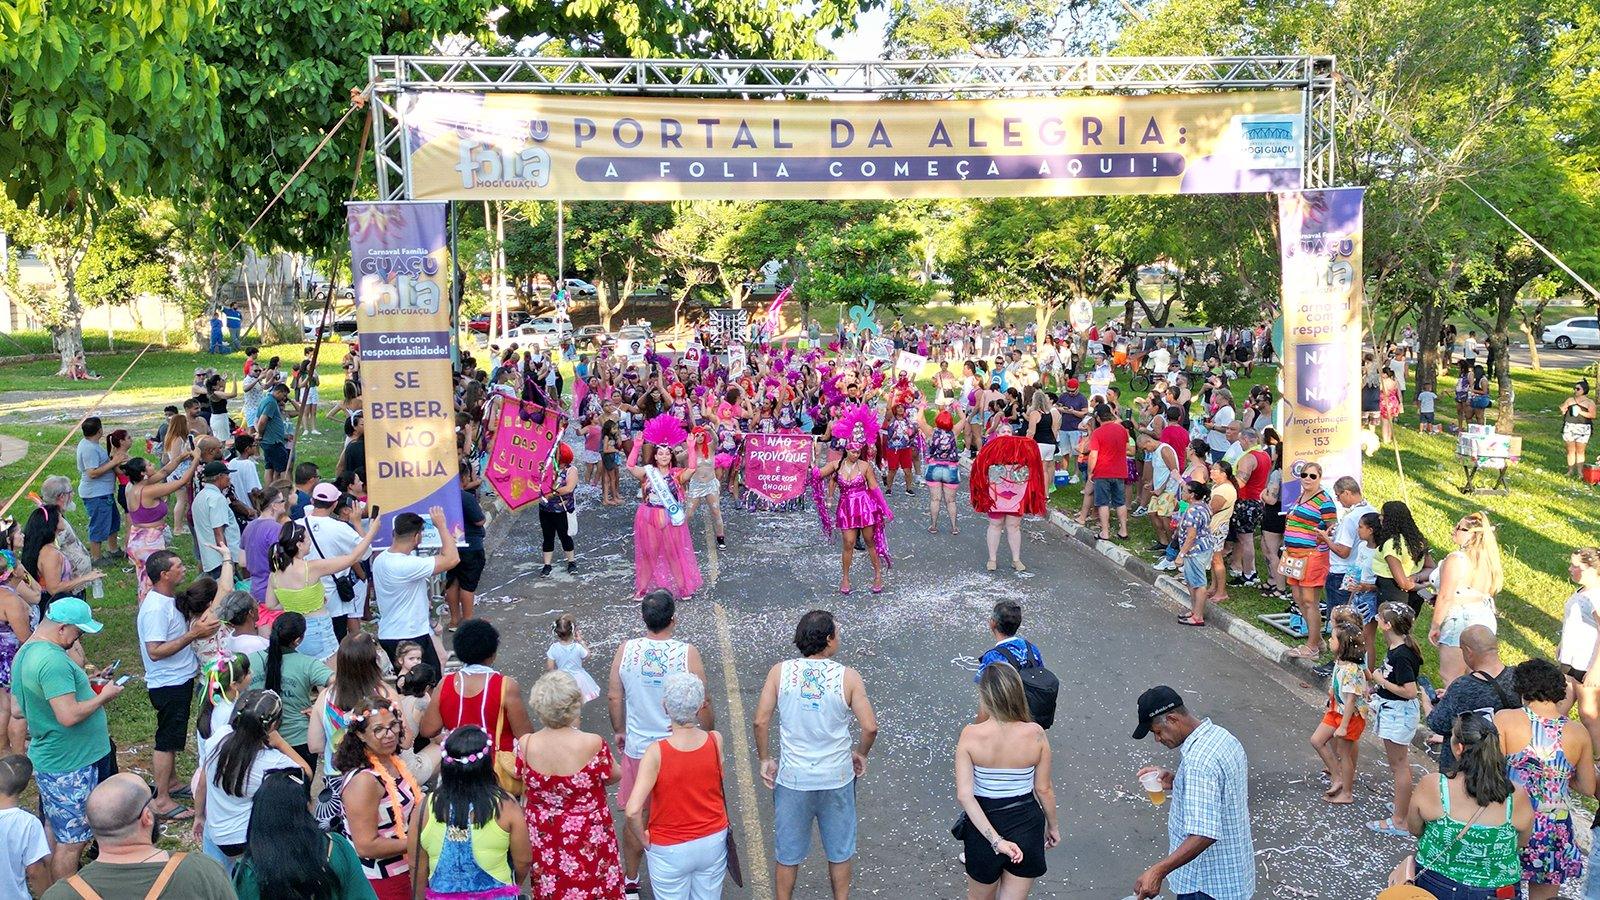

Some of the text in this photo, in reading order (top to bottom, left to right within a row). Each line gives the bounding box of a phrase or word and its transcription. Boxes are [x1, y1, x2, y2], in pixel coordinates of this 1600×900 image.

[574, 118, 793, 149] PORTAL
[831, 117, 892, 149] DA
[928, 116, 1187, 149] ALEGRIA:
[1241, 146, 1294, 155] OGI GUAÇU
[604, 157, 1158, 181] A FOLIA COMEÇA AQUI!
[476, 180, 537, 189] MOGI GUAÇU
[368, 248, 400, 256] Carnaval
[360, 256, 439, 281] GUAÇU
[377, 308, 430, 316] MOGI GUAÇU
[378, 335, 431, 344] Curta com
[362, 346, 448, 358] responsabilidade!
[394, 371, 421, 389] SE
[371, 401, 448, 420] BEBER,
[504, 415, 554, 441] BLOCO
[386, 426, 436, 449] NÃO
[512, 434, 538, 452] DAS
[1312, 436, 1330, 447] 153
[750, 450, 808, 463] PROVOQUE
[378, 460, 448, 479] DIRIJA
[762, 483, 793, 492] CHOQUE
